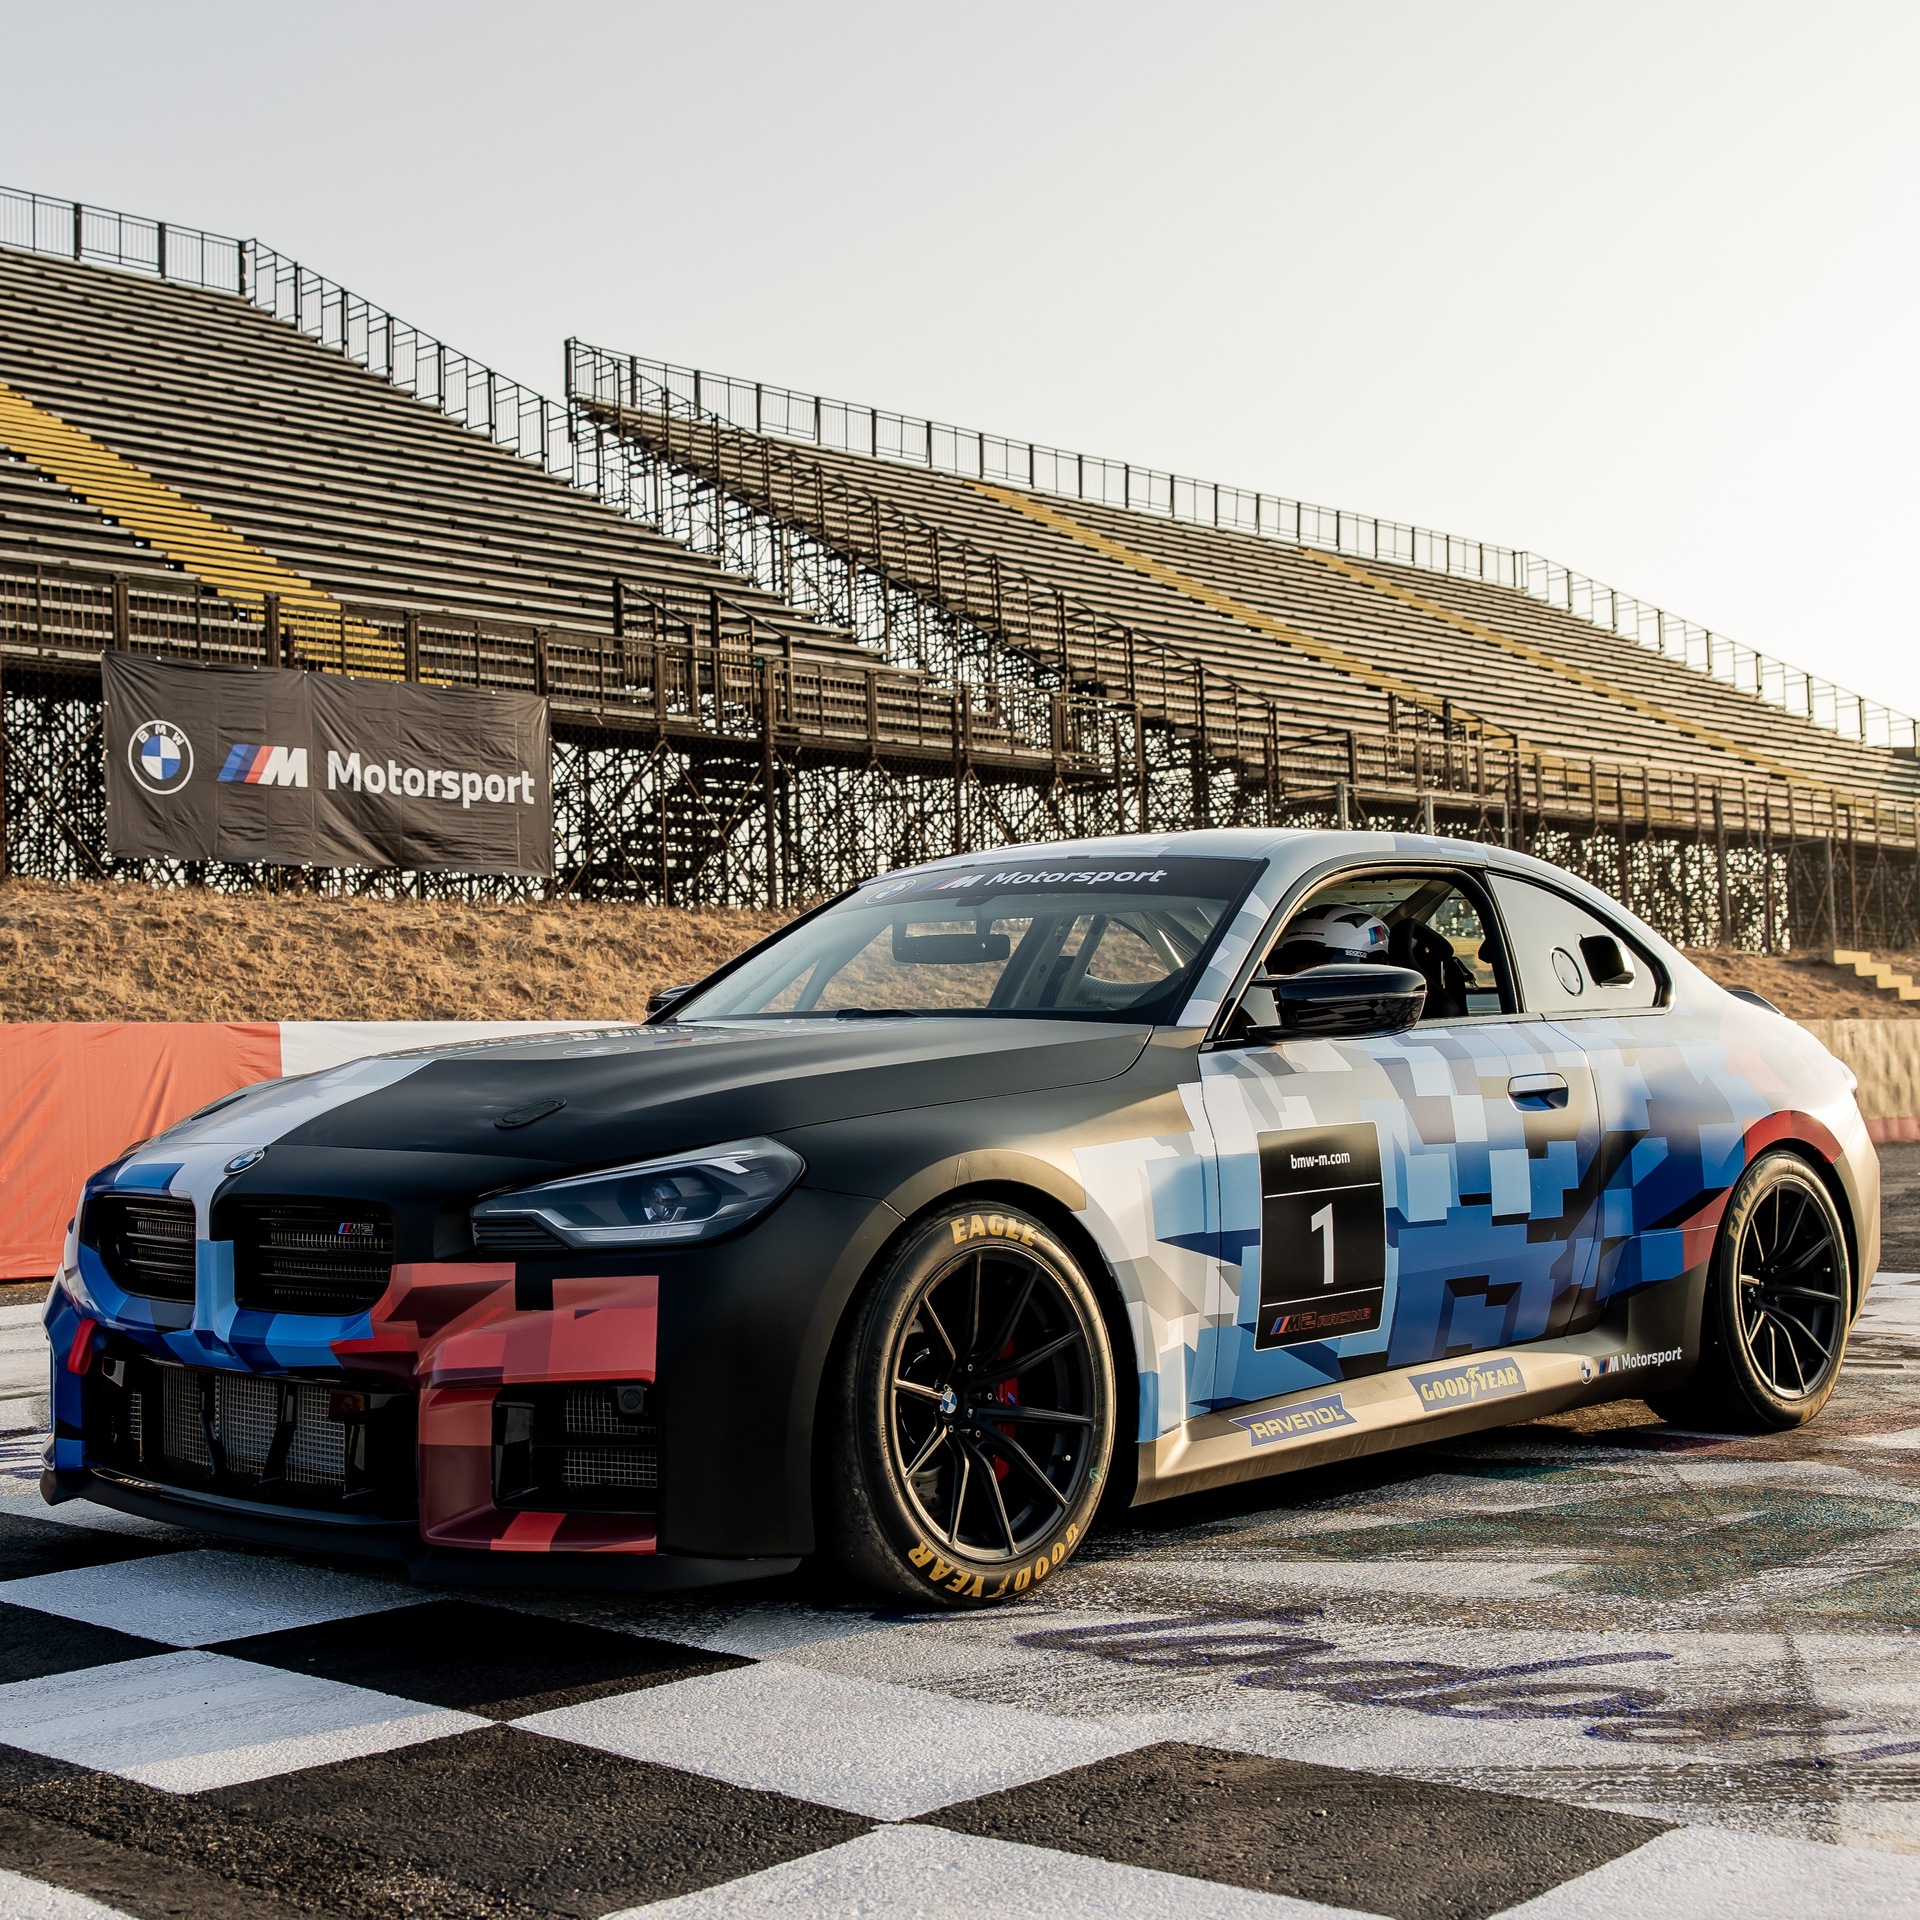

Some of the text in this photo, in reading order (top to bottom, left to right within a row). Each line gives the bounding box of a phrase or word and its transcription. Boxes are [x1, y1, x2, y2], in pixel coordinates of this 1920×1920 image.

[137, 724, 185, 746] BMW
[327, 750, 535, 809] Motorsport
[984, 869, 1168, 885] Motorsport
[1290, 1152, 1351, 1169] bmw-m.com
[950, 1214, 1037, 1247] EAGLE
[1311, 1202, 1334, 1285] 1
[1317, 1307, 1372, 1328] RACING
[1621, 1346, 1682, 1370] Motorsport
[1250, 1405, 1346, 1438] RAVENOL
